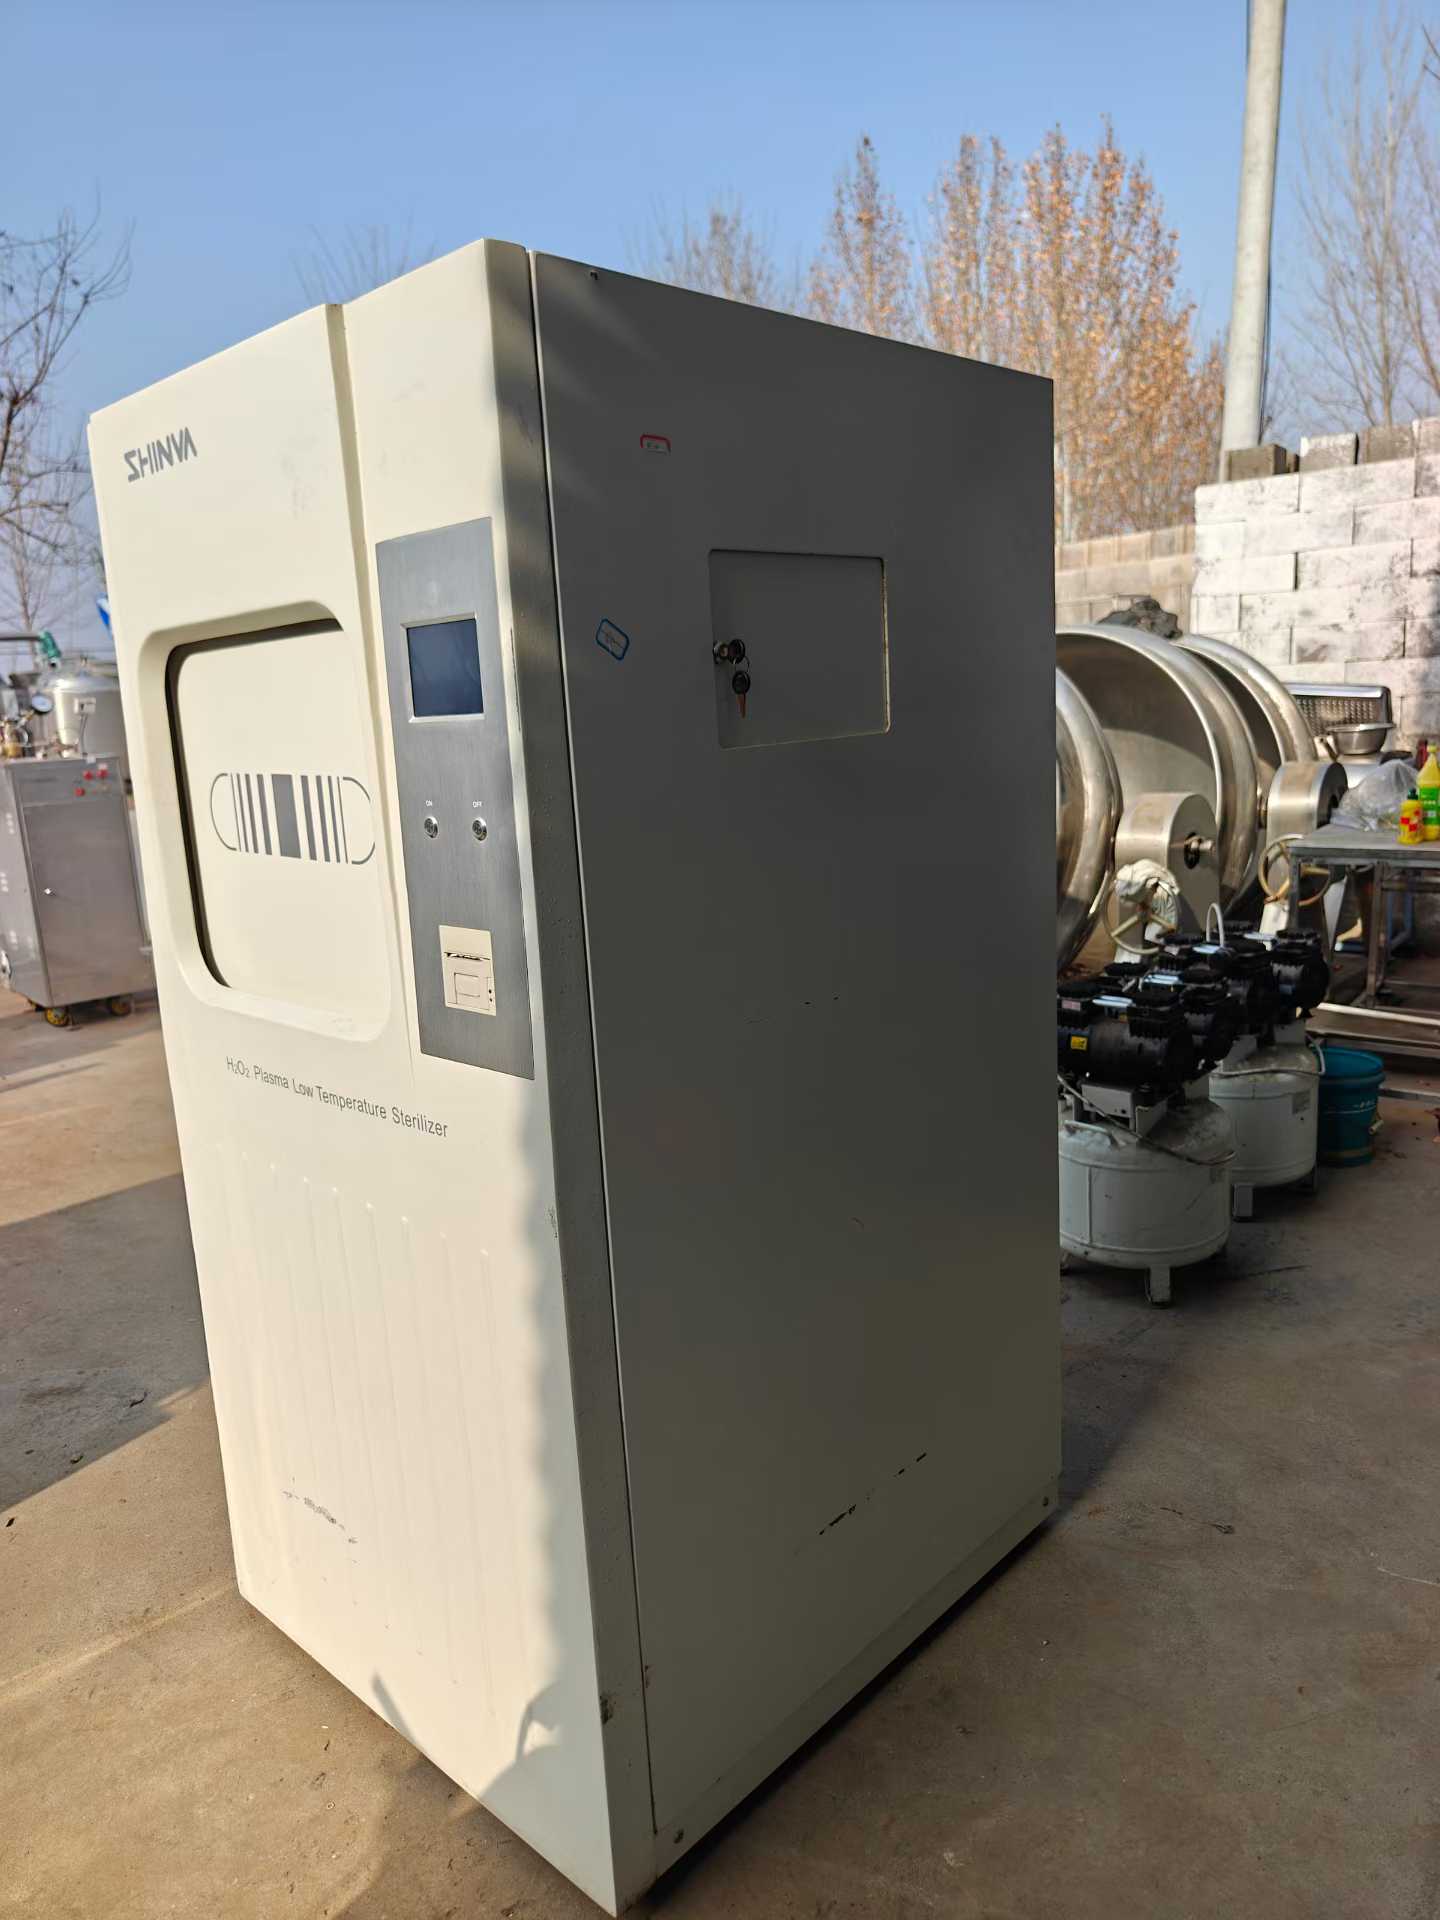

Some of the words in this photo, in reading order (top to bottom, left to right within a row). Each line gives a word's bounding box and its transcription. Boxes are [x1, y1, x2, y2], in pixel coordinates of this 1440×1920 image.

[124, 427, 197, 482] SHINVA
[254, 1065, 289, 1089] Plasma
[292, 1078, 314, 1098] Low
[315, 1085, 387, 1119] Temperature
[391, 1106, 448, 1138] Sterilizer
